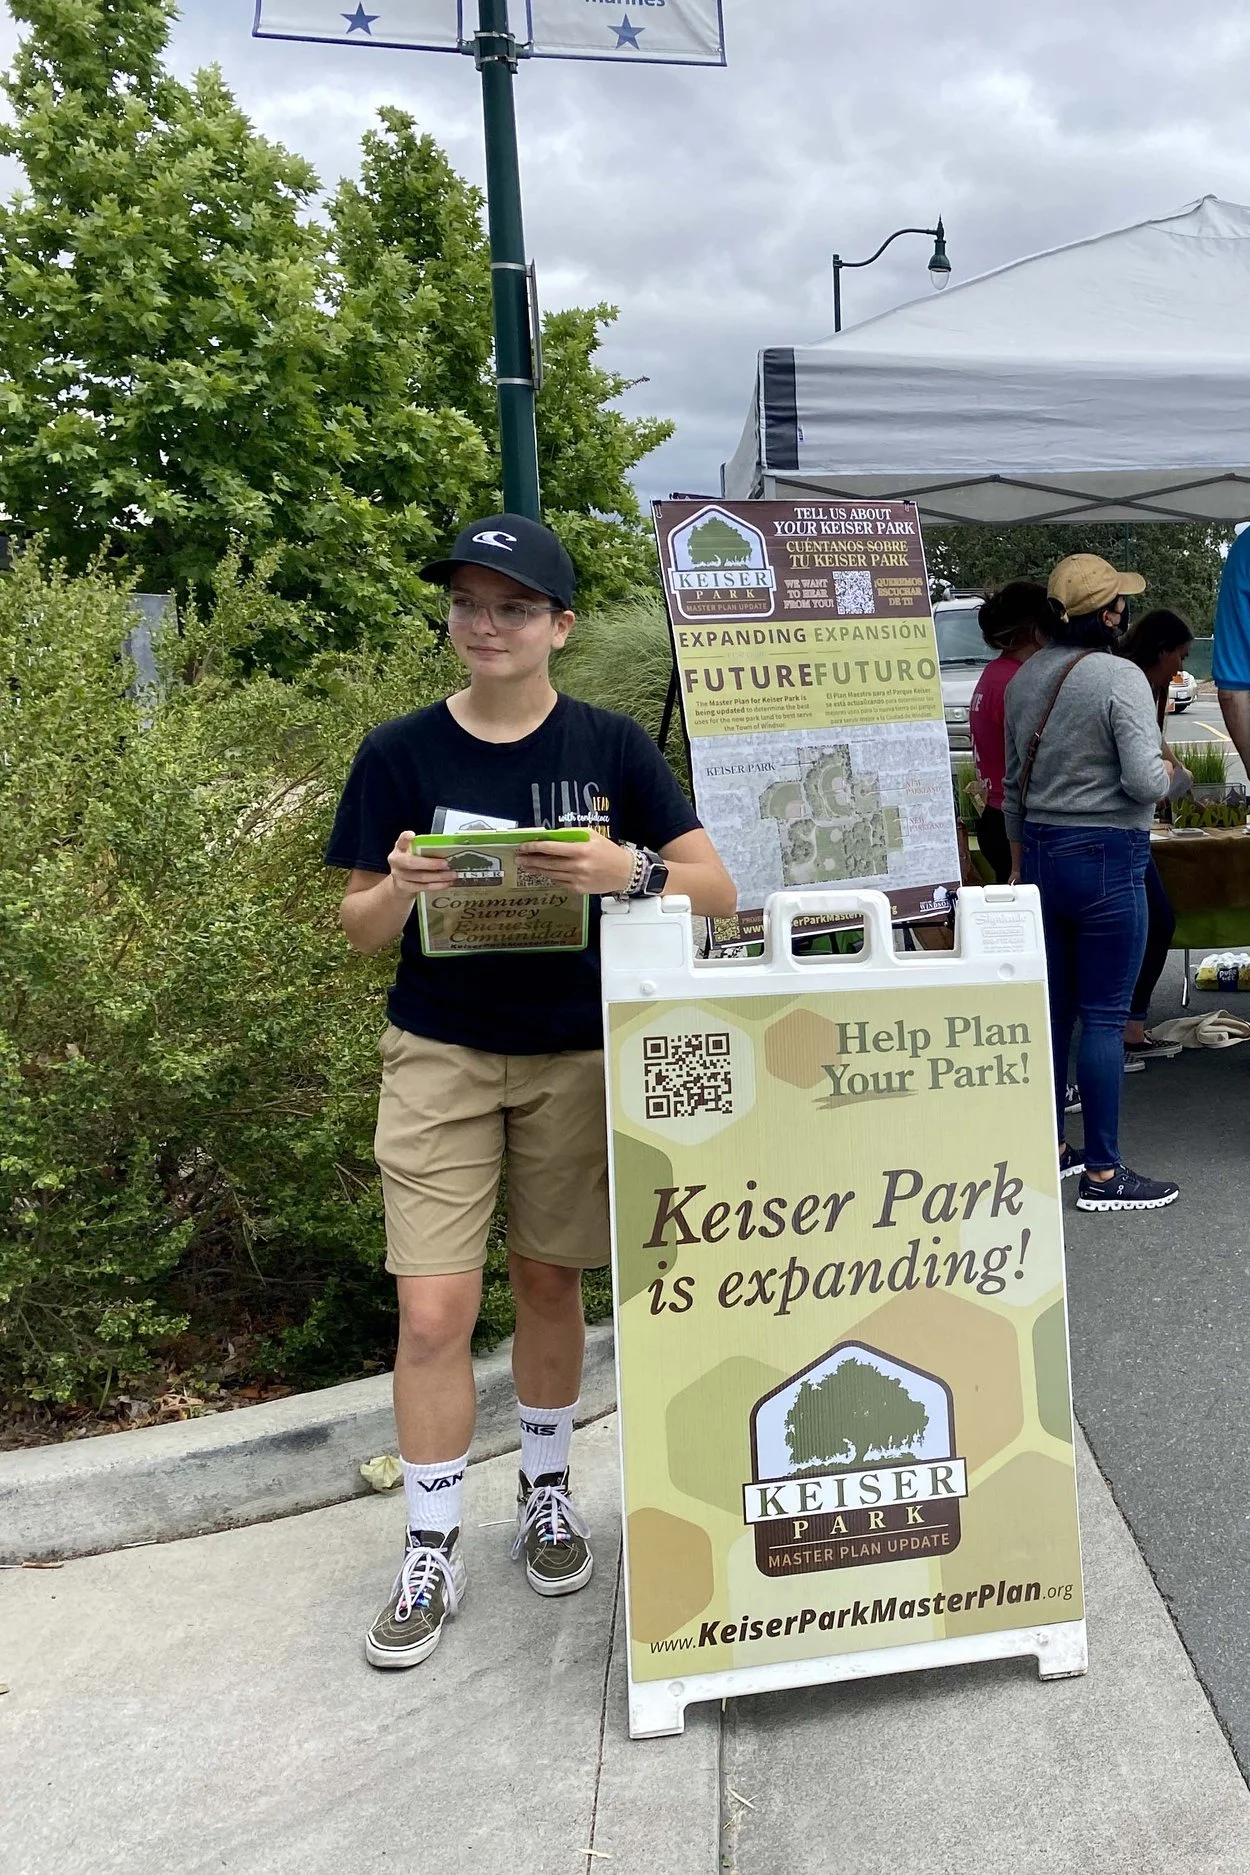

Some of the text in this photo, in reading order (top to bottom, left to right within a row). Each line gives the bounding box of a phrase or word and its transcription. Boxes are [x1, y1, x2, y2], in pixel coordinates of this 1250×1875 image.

[794, 508, 892, 521] TELL US ABOUT
[773, 521, 916, 535] YOUR KEISER PARK
[786, 538, 908, 553] CUÉNTANOS SOBRE
[790, 553, 910, 568] TU KEISER PARK
[679, 572, 768, 588] KEISER
[784, 579, 828, 588] WE WANT
[696, 589, 755, 600] PARK
[787, 589, 828, 598] TO HEAR
[877, 587, 922, 596] ESCUCHAR
[686, 602, 767, 612] MASTER PLAN UPDATE
[784, 599, 834, 610] FROM YOU!
[888, 598, 901, 606] DE
[679, 621, 928, 648] EXPANDING EXPANSIÓN
[684, 658, 936, 693] FUTURE FUTURO
[696, 709, 716, 717] being
[717, 706, 745, 715] updated
[706, 762, 776, 776] KEISER PARK
[592, 796, 610, 811] LEAD
[558, 811, 610, 824] with confidence
[432, 893, 568, 910] Community
[460, 907, 540, 920] Survey
[454, 919, 552, 932] Encuesta
[450, 927, 576, 943] Comunidad
[835, 1015, 1031, 1058] Help Plan
[821, 1052, 1030, 1098] Your Park!
[642, 1160, 1024, 1249] Keiser Park
[649, 1228, 1032, 1317] is expanding!
[520, 1420, 558, 1436] ANS
[417, 1471, 463, 1493] VAN
[756, 1464, 957, 1519] KEISER
[792, 1505, 925, 1540] PARK
[768, 1533, 951, 1569] MASTER PLAN UPDATE
[649, 1579, 1074, 1654] www.KeiserParkMasterPlan.org
